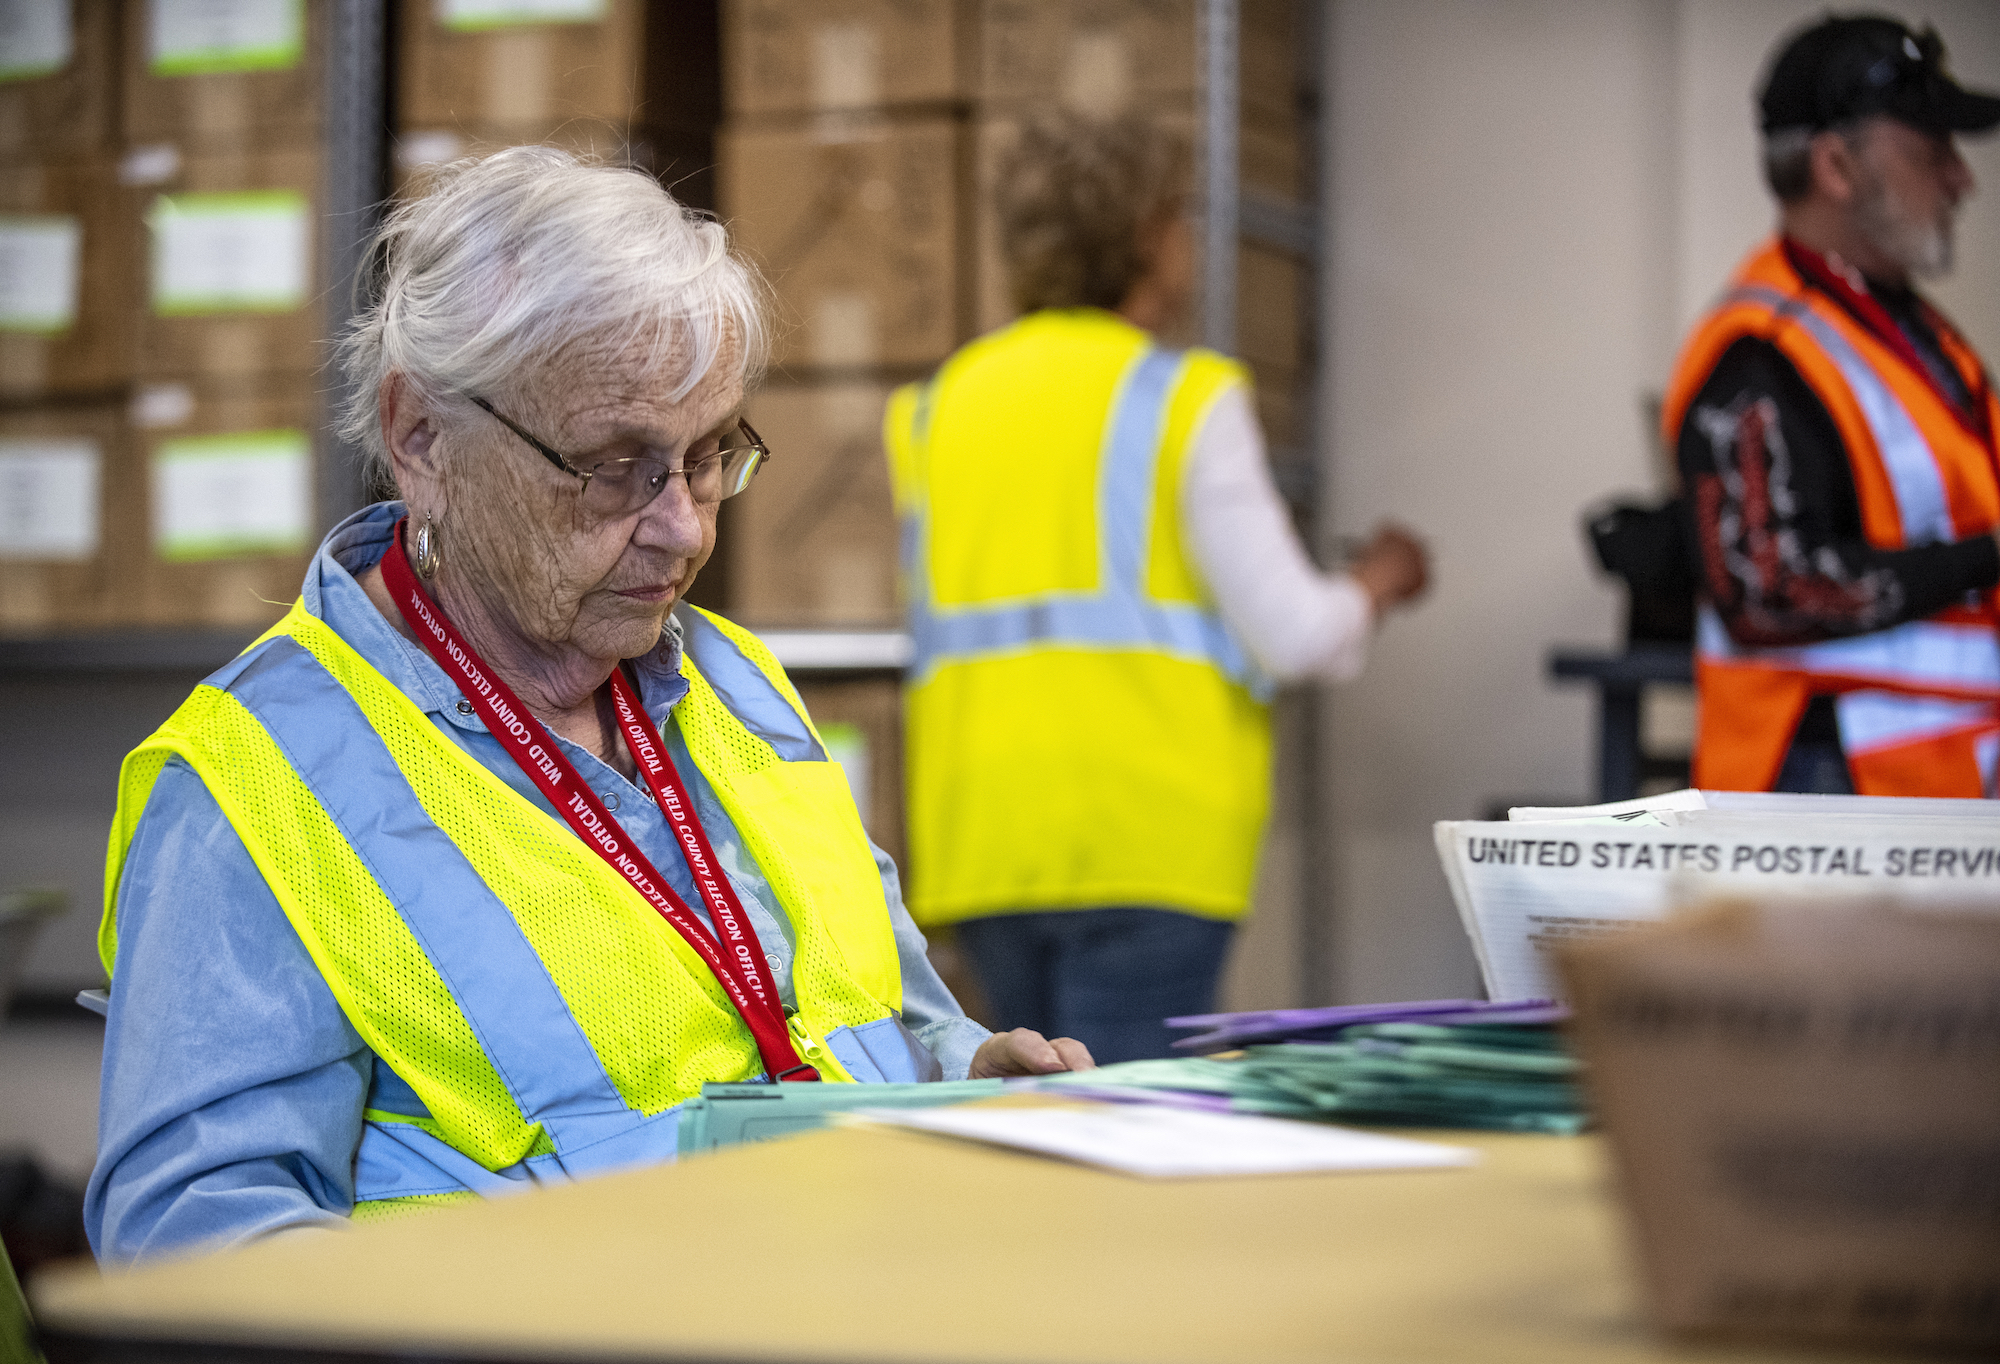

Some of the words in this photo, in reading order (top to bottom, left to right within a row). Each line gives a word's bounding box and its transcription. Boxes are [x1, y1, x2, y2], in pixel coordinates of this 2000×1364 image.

[411, 589, 446, 643] OFFICIAL
[445, 638, 493, 696] ELECTION
[486, 693, 532, 745] COUNTY
[528, 745, 563, 786] WELD
[628, 725, 664, 775] OFFICIAL
[567, 791, 619, 854] OFFICIAL
[1467, 837, 1580, 867] UNITED
[1591, 842, 1719, 873] STATES
[1731, 845, 1871, 876] POSTAL
[1884, 847, 2000, 878] SERVI
[614, 855, 674, 914] ELECTION
[660, 784, 686, 822] WELD
[678, 824, 713, 878] COUNTY
[704, 879, 743, 941] ELECTION
[735, 944, 768, 1006] OFFICIA
[671, 913, 720, 965] COUNTY
[720, 968, 748, 1008] WELD
